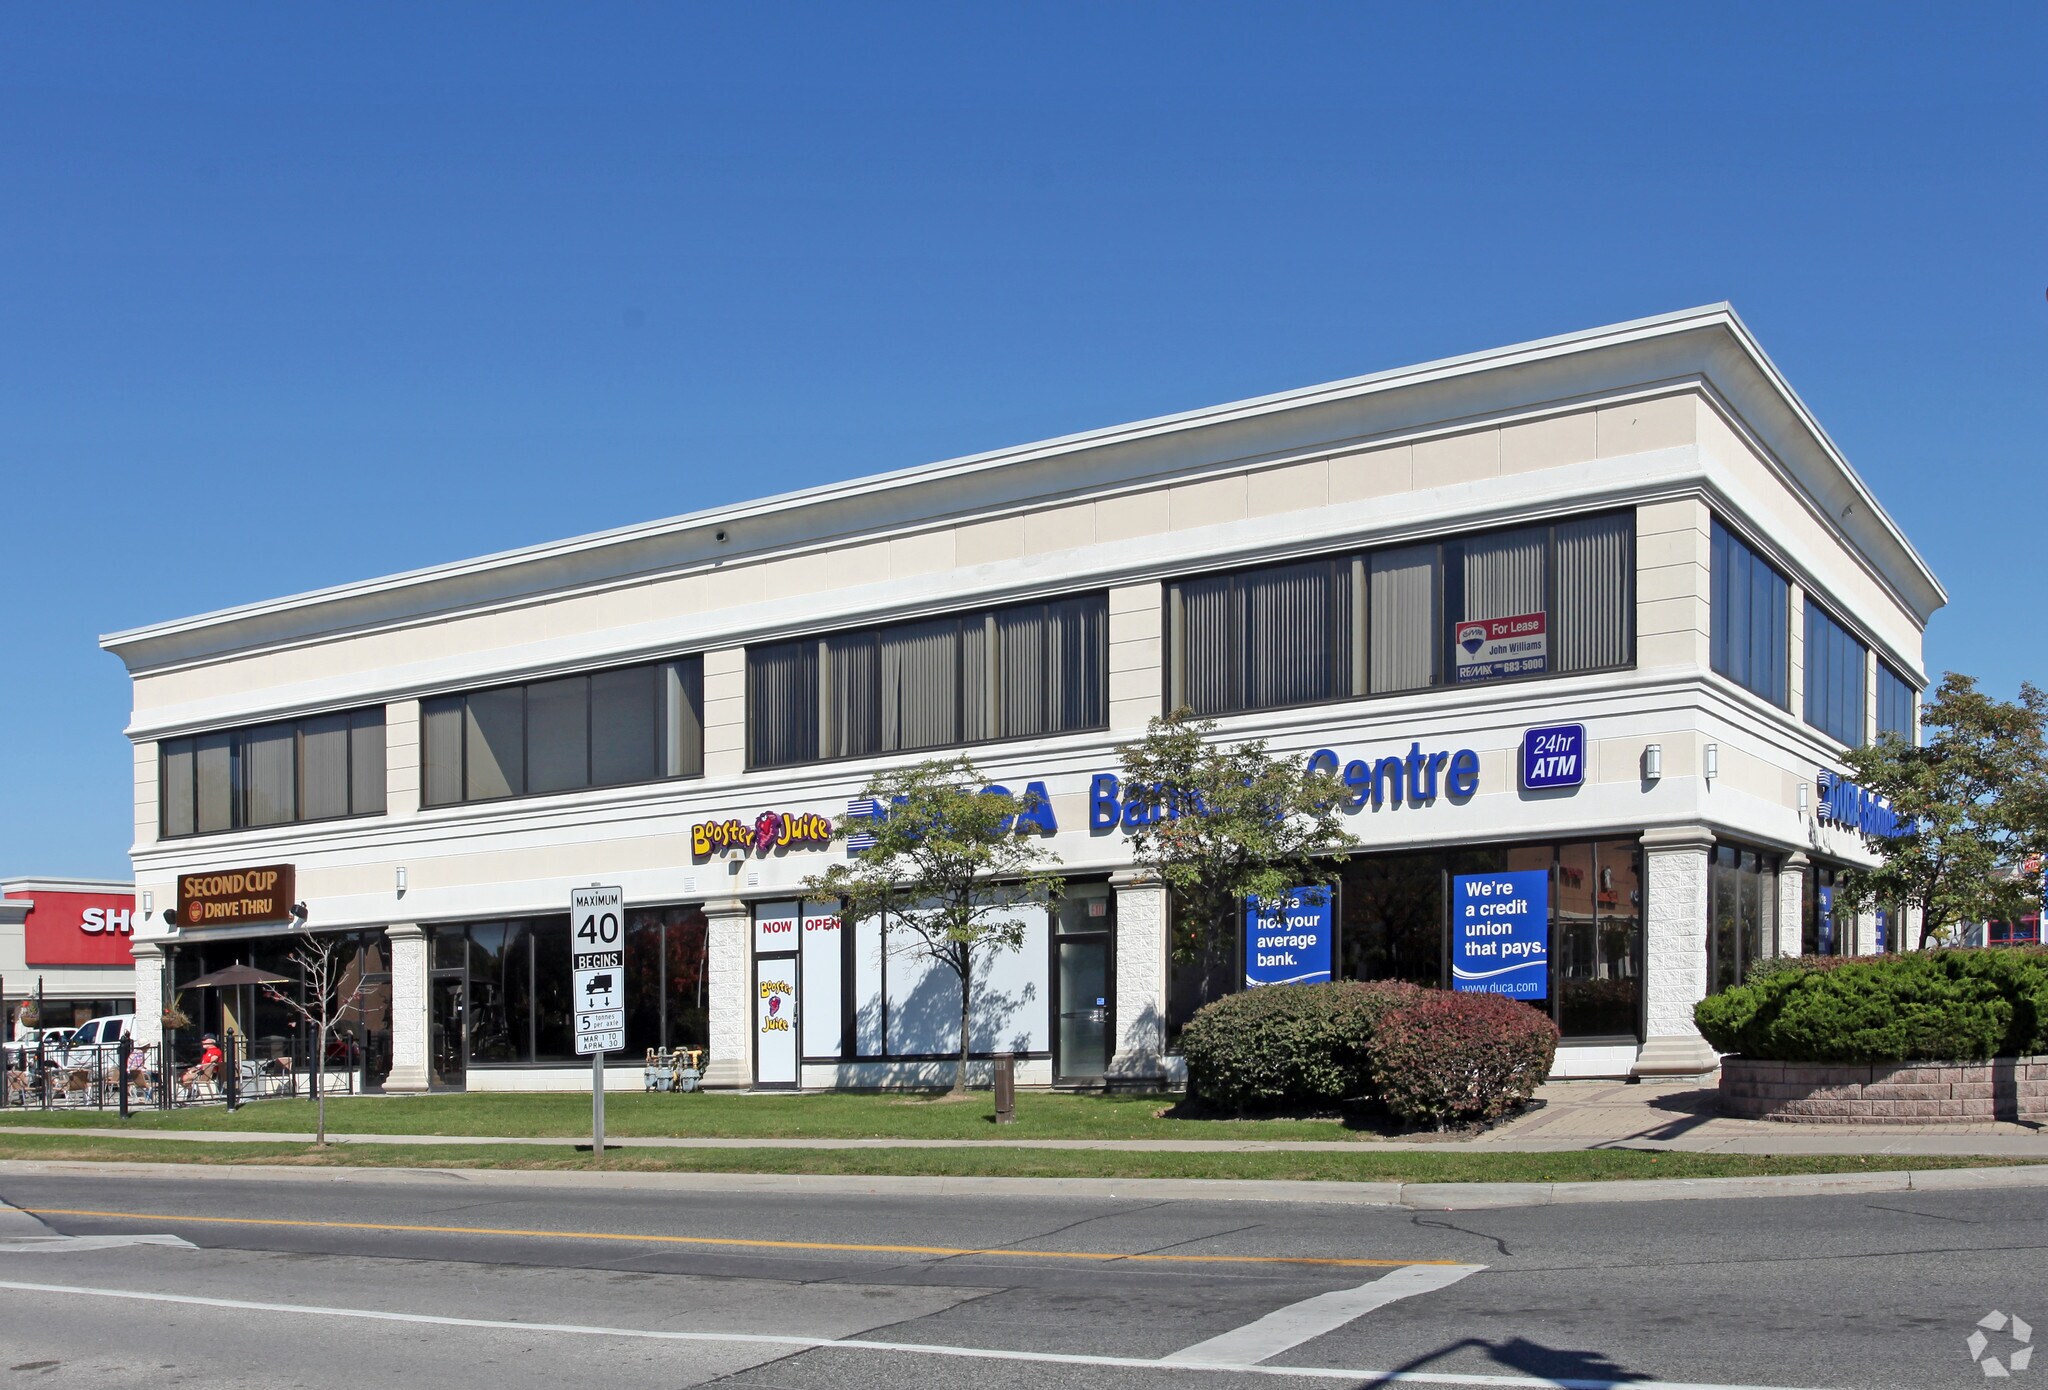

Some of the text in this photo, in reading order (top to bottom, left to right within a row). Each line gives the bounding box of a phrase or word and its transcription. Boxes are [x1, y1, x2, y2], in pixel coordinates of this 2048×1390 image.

[1492, 620, 1539, 635] For Lease
[1489, 641, 1542, 655] John Williams
[1459, 664, 1493, 678] RE/MAX
[1504, 658, 1543, 673] 683-5000
[1533, 733, 1575, 755] 24hr
[1307, 741, 1481, 808] Centre
[1530, 754, 1577, 779] ATM
[692, 812, 830, 857] Booster Juice
[1465, 880, 1513, 897] We're
[204, 898, 273, 919] DRIVE THRU
[576, 894, 618, 907] MAXIMUM
[1465, 899, 1528, 917] a credit
[80, 907, 136, 932] SH
[577, 912, 618, 944] 40
[763, 919, 840, 934] NOW OPEN
[1257, 915, 1321, 932] not your
[1465, 920, 1512, 937] union
[1257, 934, 1317, 950] average
[1464, 941, 1546, 958] that pays.
[578, 953, 618, 969] BEGINS
[1257, 951, 1298, 967] bank.
[760, 980, 794, 998] Booster
[1461, 982, 1538, 993] wwwduca.com
[582, 1015, 591, 1030] 5
[762, 1016, 789, 1033] Juice
[583, 1035, 599, 1043] MAR
[608, 1032, 617, 1040] TO
[608, 1039, 618, 1047] 30
